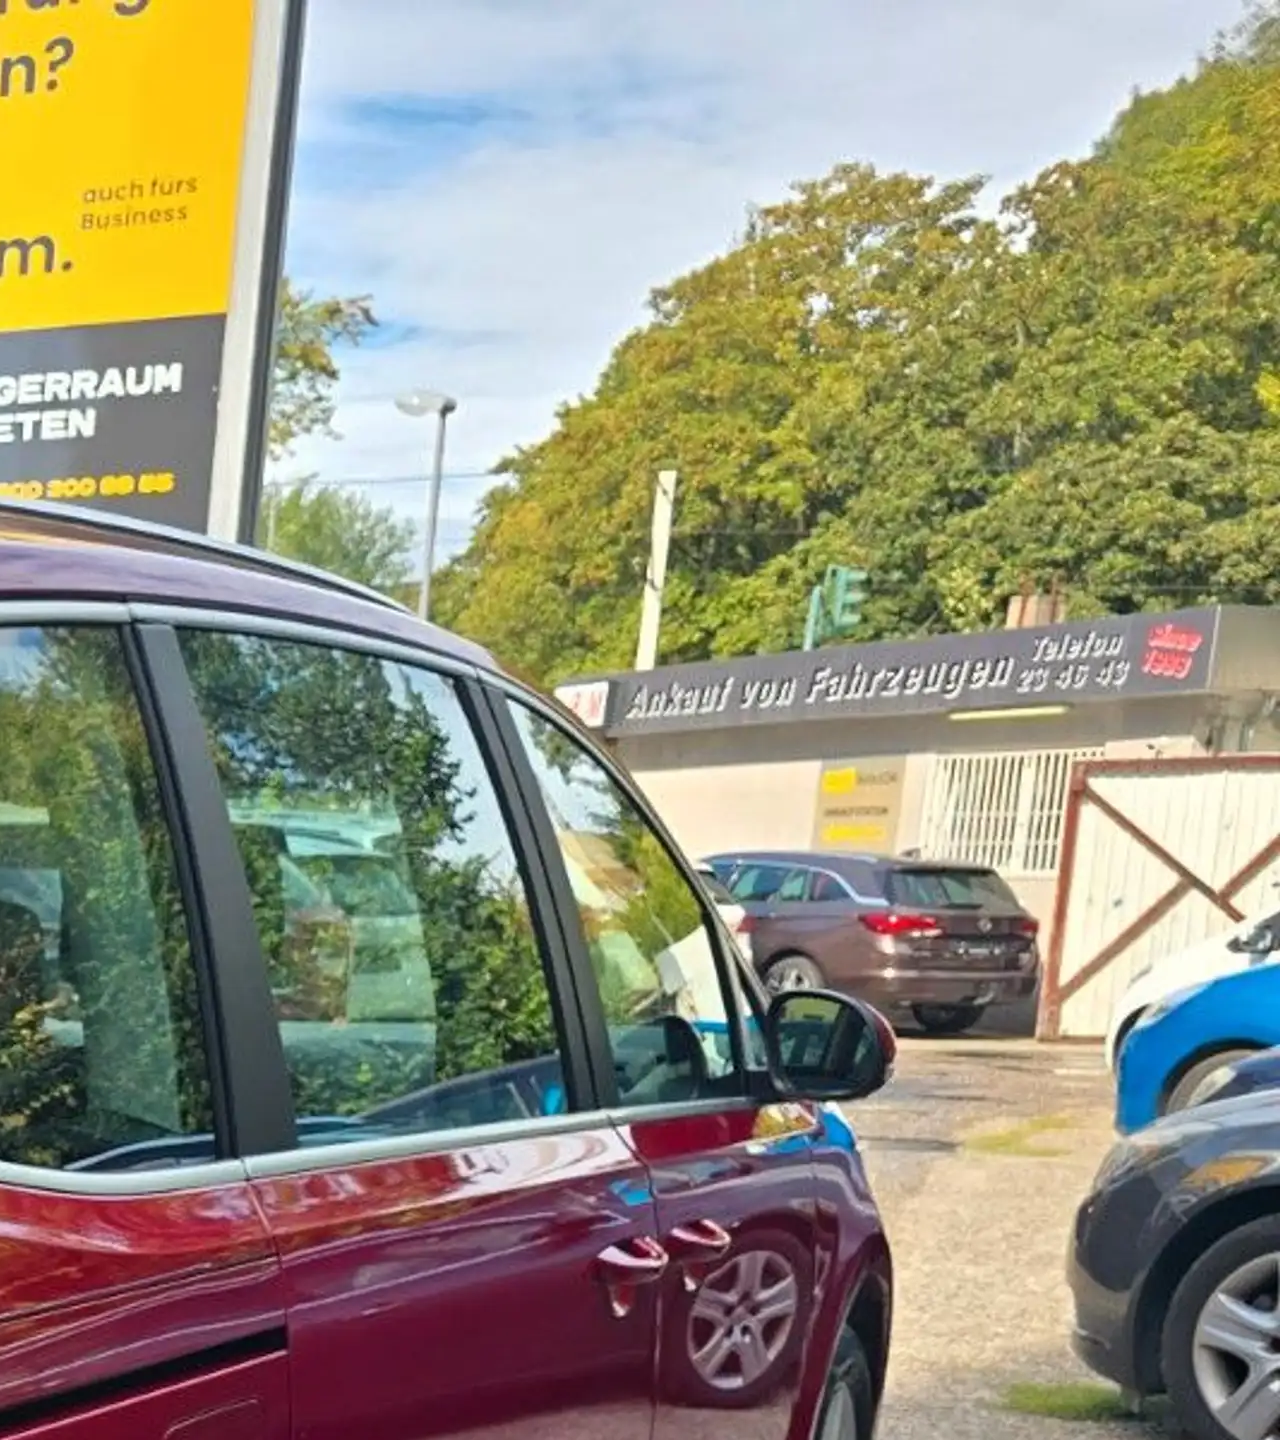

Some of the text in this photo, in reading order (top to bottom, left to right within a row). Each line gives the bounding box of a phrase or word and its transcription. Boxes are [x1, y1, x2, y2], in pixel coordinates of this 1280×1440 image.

[83, 179, 144, 204] auch
[81, 204, 188, 231] Business
[1031, 630, 1125, 662] Telefon
[625, 676, 735, 720] Ankauf
[740, 678, 797, 710] von
[806, 657, 1015, 704] Fahrzeugen
